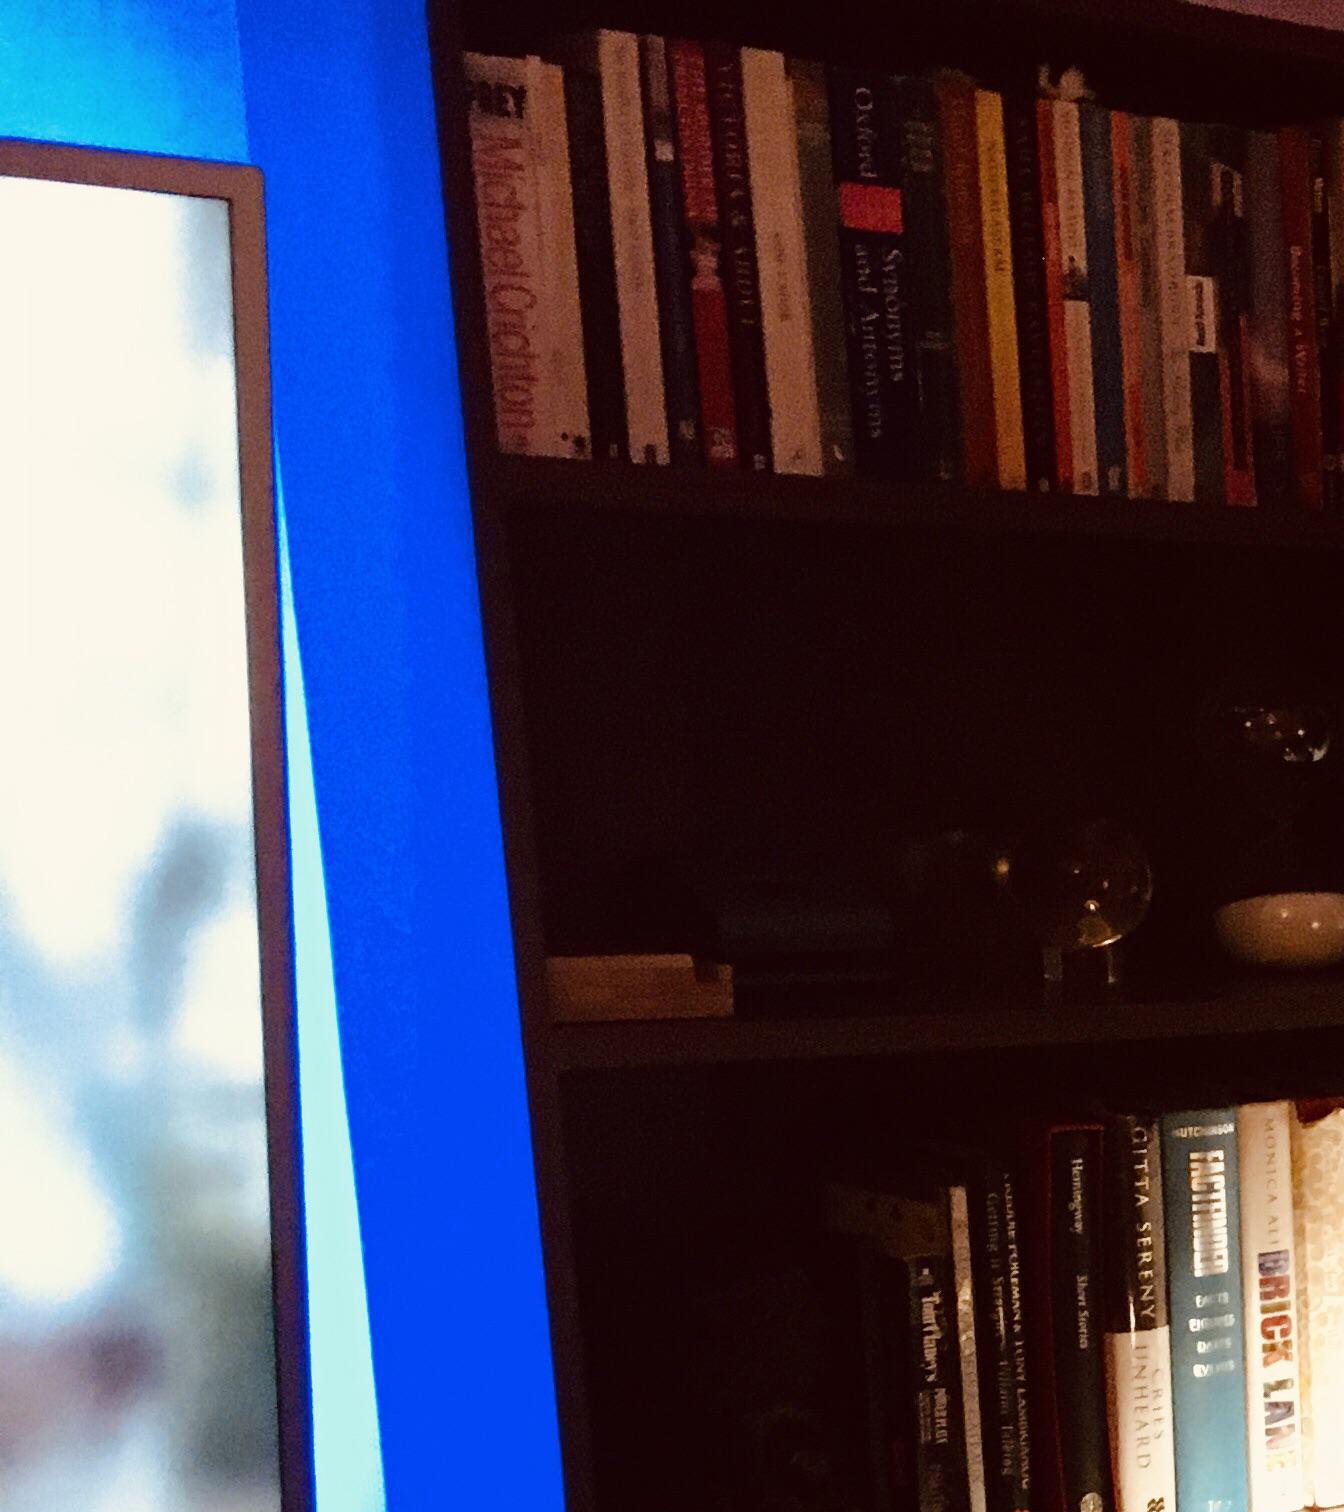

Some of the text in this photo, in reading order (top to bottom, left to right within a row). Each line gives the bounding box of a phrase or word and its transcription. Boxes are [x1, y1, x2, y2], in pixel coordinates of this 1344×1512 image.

[854, 87, 878, 178] Oxford
[474, 134, 540, 431] Michael Crichton
[855, 244, 885, 438] and Antonyms
[881, 247, 906, 382] Synonyms
[1069, 1157, 1084, 1235] Hemingway
[1131, 1124, 1157, 1329] GITTA SERENY
[1188, 1149, 1230, 1279] FACTFINDER
[1264, 1115, 1279, 1246] MONICA ALI
[1075, 1274, 1089, 1350] Short Stories
[1258, 1249, 1300, 1474] BRICK LANE
[1133, 1343, 1153, 1471] UNHEARD
[1150, 1365, 1166, 1442] CRIES
